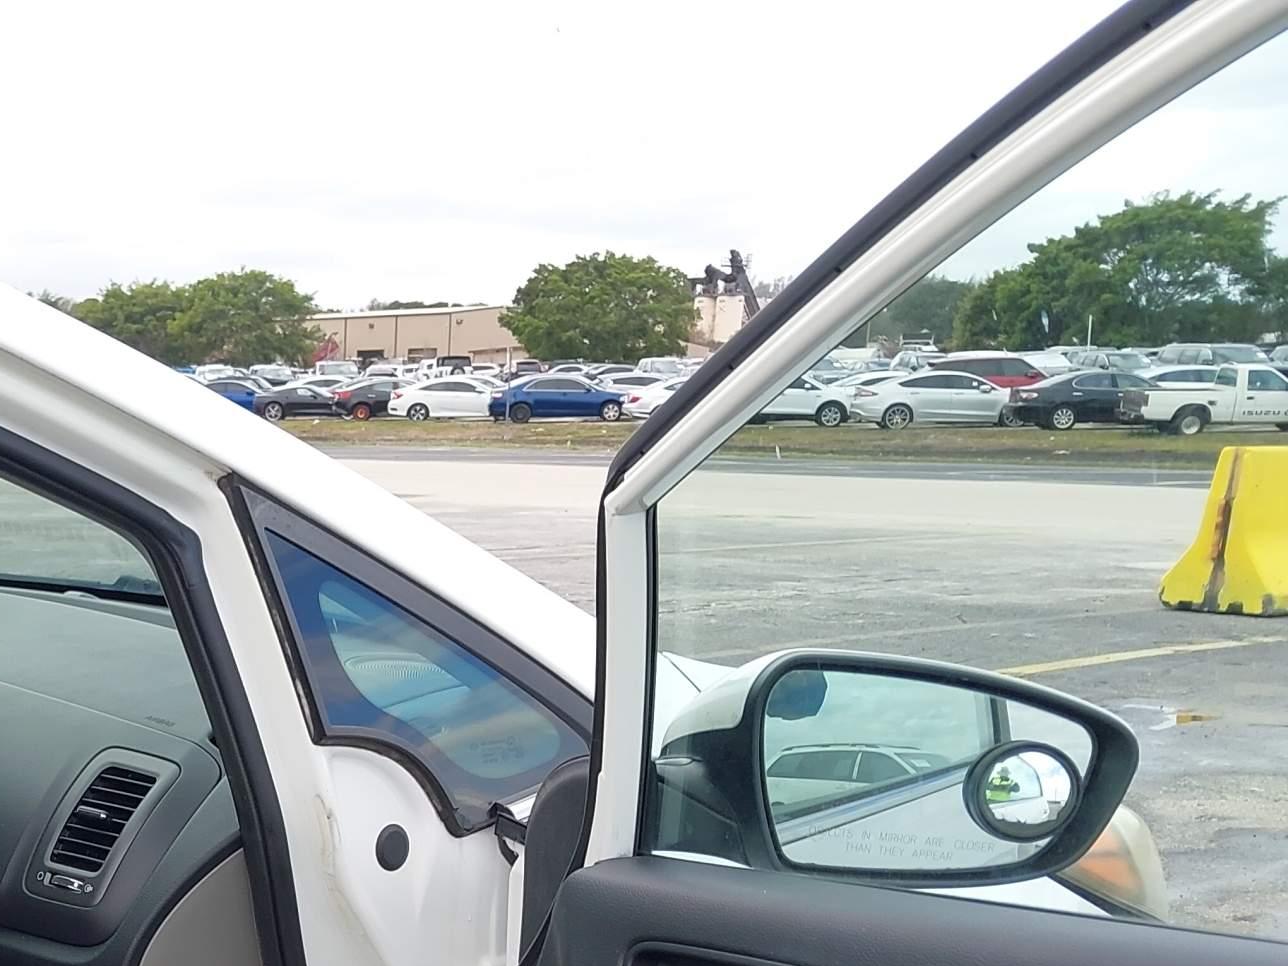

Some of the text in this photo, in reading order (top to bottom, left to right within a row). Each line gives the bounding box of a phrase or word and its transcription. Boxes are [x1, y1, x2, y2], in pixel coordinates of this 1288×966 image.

[845, 841, 954, 862] THAN THEY APPEAR
[861, 830, 872, 840] IN
[879, 831, 917, 845] MIRROR
[924, 836, 945, 849] ARE
[953, 839, 995, 853] CLOSER
